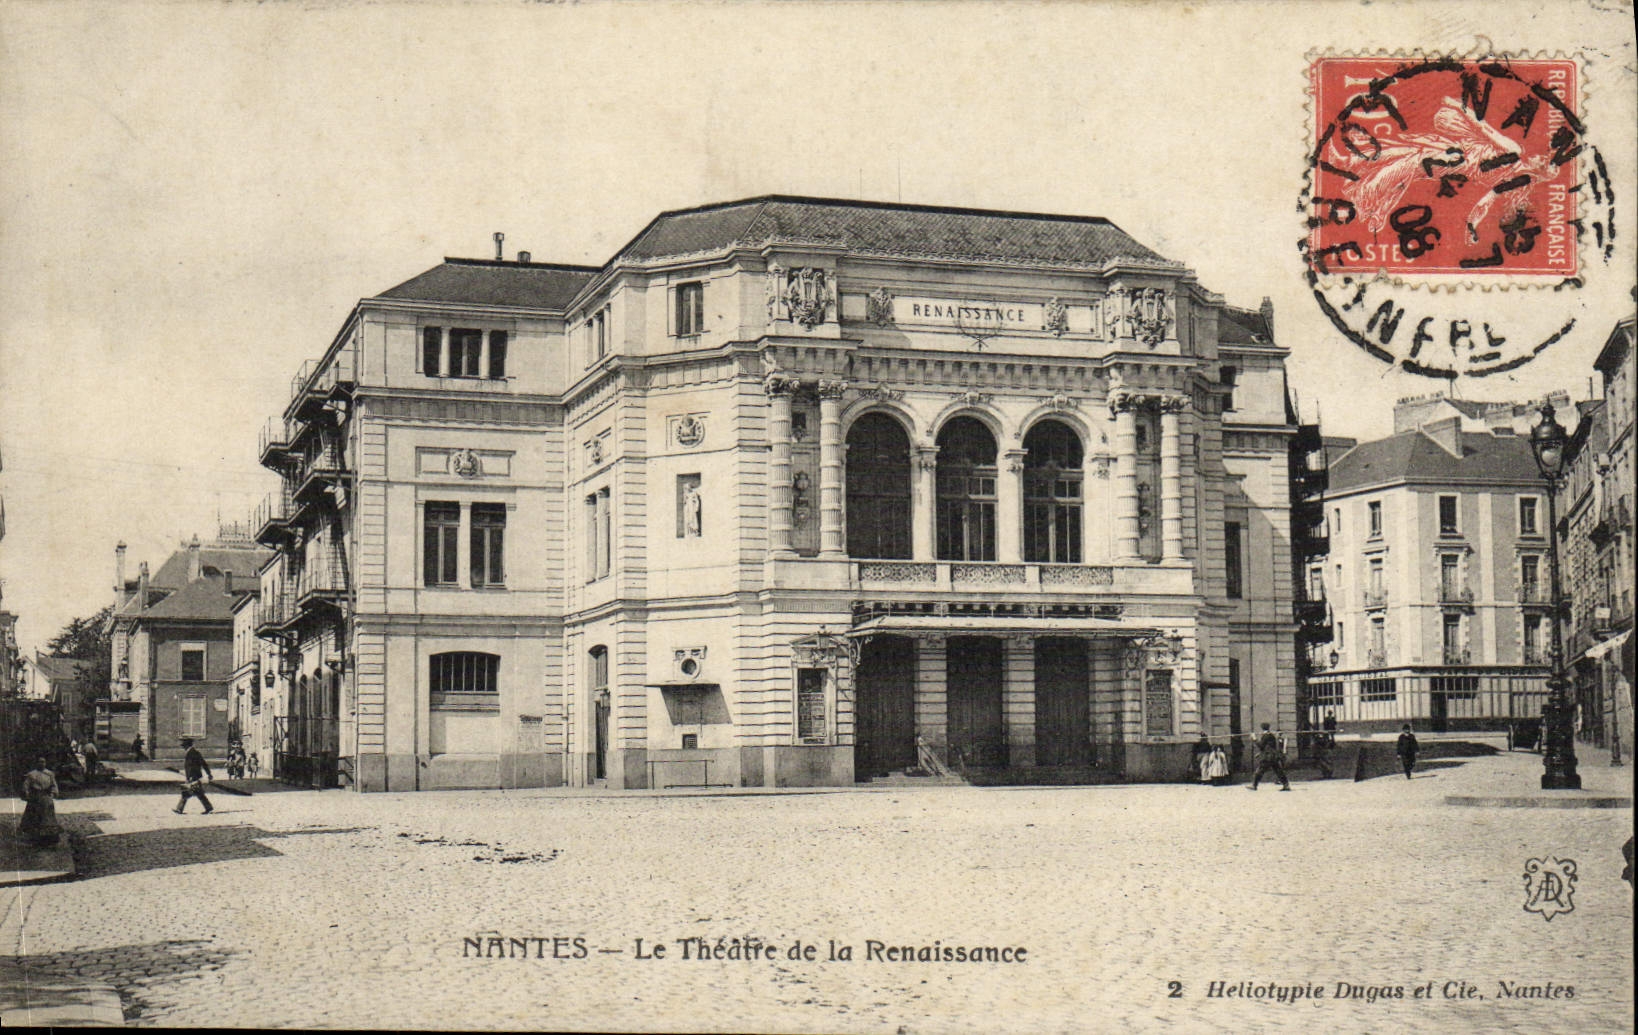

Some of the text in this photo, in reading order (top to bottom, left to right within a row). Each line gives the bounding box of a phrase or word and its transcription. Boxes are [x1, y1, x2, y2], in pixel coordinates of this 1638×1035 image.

[1545, 184, 1566, 265] FRANÇAISE
[1331, 242, 1416, 264] OSTE
[912, 302, 1026, 323] RENAISSANCE
